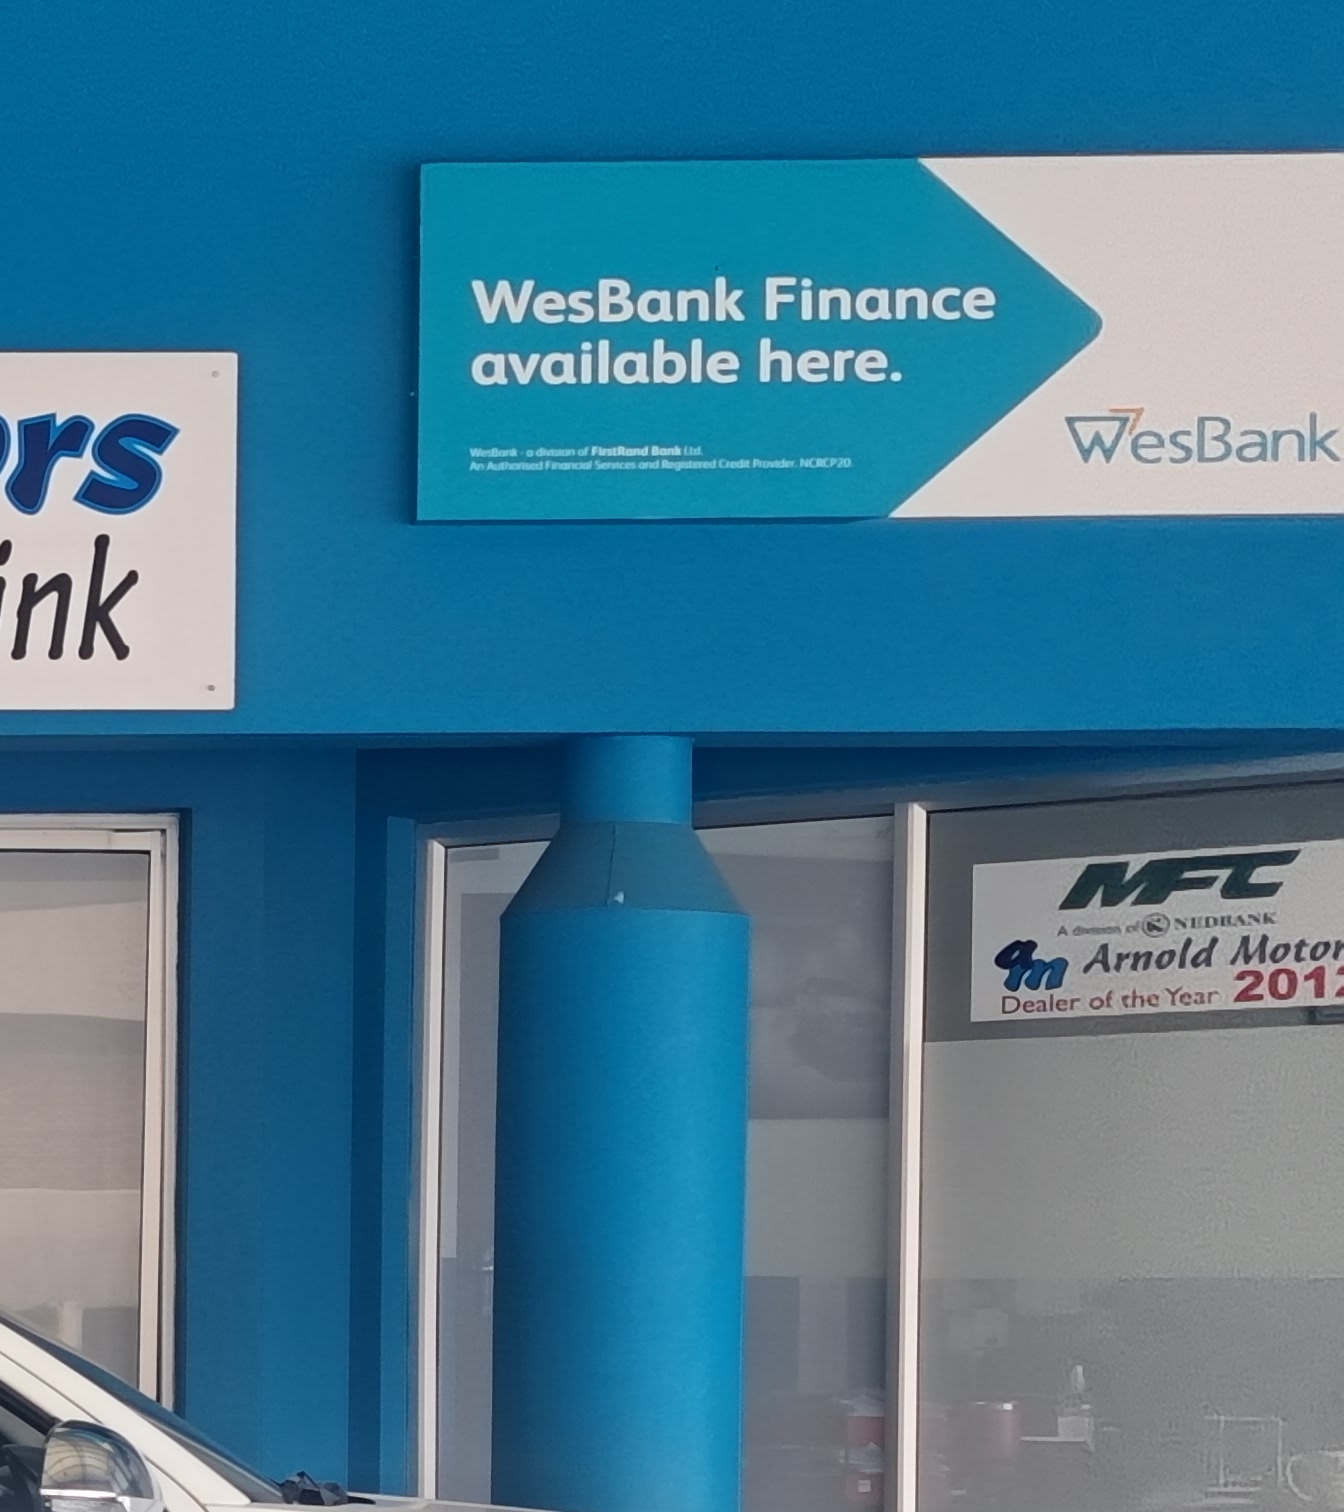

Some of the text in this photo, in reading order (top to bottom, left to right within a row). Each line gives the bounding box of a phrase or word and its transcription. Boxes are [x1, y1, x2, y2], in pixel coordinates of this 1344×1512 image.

[471, 276, 997, 325] WesBank Finance
[471, 336, 903, 387] available here.
[469, 447, 518, 458] WesBank
[535, 446, 575, 458] division
[577, 446, 590, 457] of
[591, 445, 648, 457] FirstRand
[651, 445, 682, 456] Bank
[1064, 410, 1342, 465] WesBank
[469, 460, 485, 471] An
[486, 460, 544, 471] Authorised
[545, 460, 592, 471] Financial
[594, 460, 637, 470] Services
[638, 459, 659, 470] and
[660, 459, 717, 472] Registered
[718, 458, 751, 469] Credit
[1058, 848, 1302, 911] MFC
[1057, 925, 1069, 937] A
[1173, 911, 1278, 931] NEDBANK
[1082, 936, 1219, 974] Arnold
[1001, 994, 1081, 1015] Dealer
[1088, 988, 1115, 1011] of
[1121, 988, 1160, 1009] the
[1164, 986, 1220, 1007] Year
